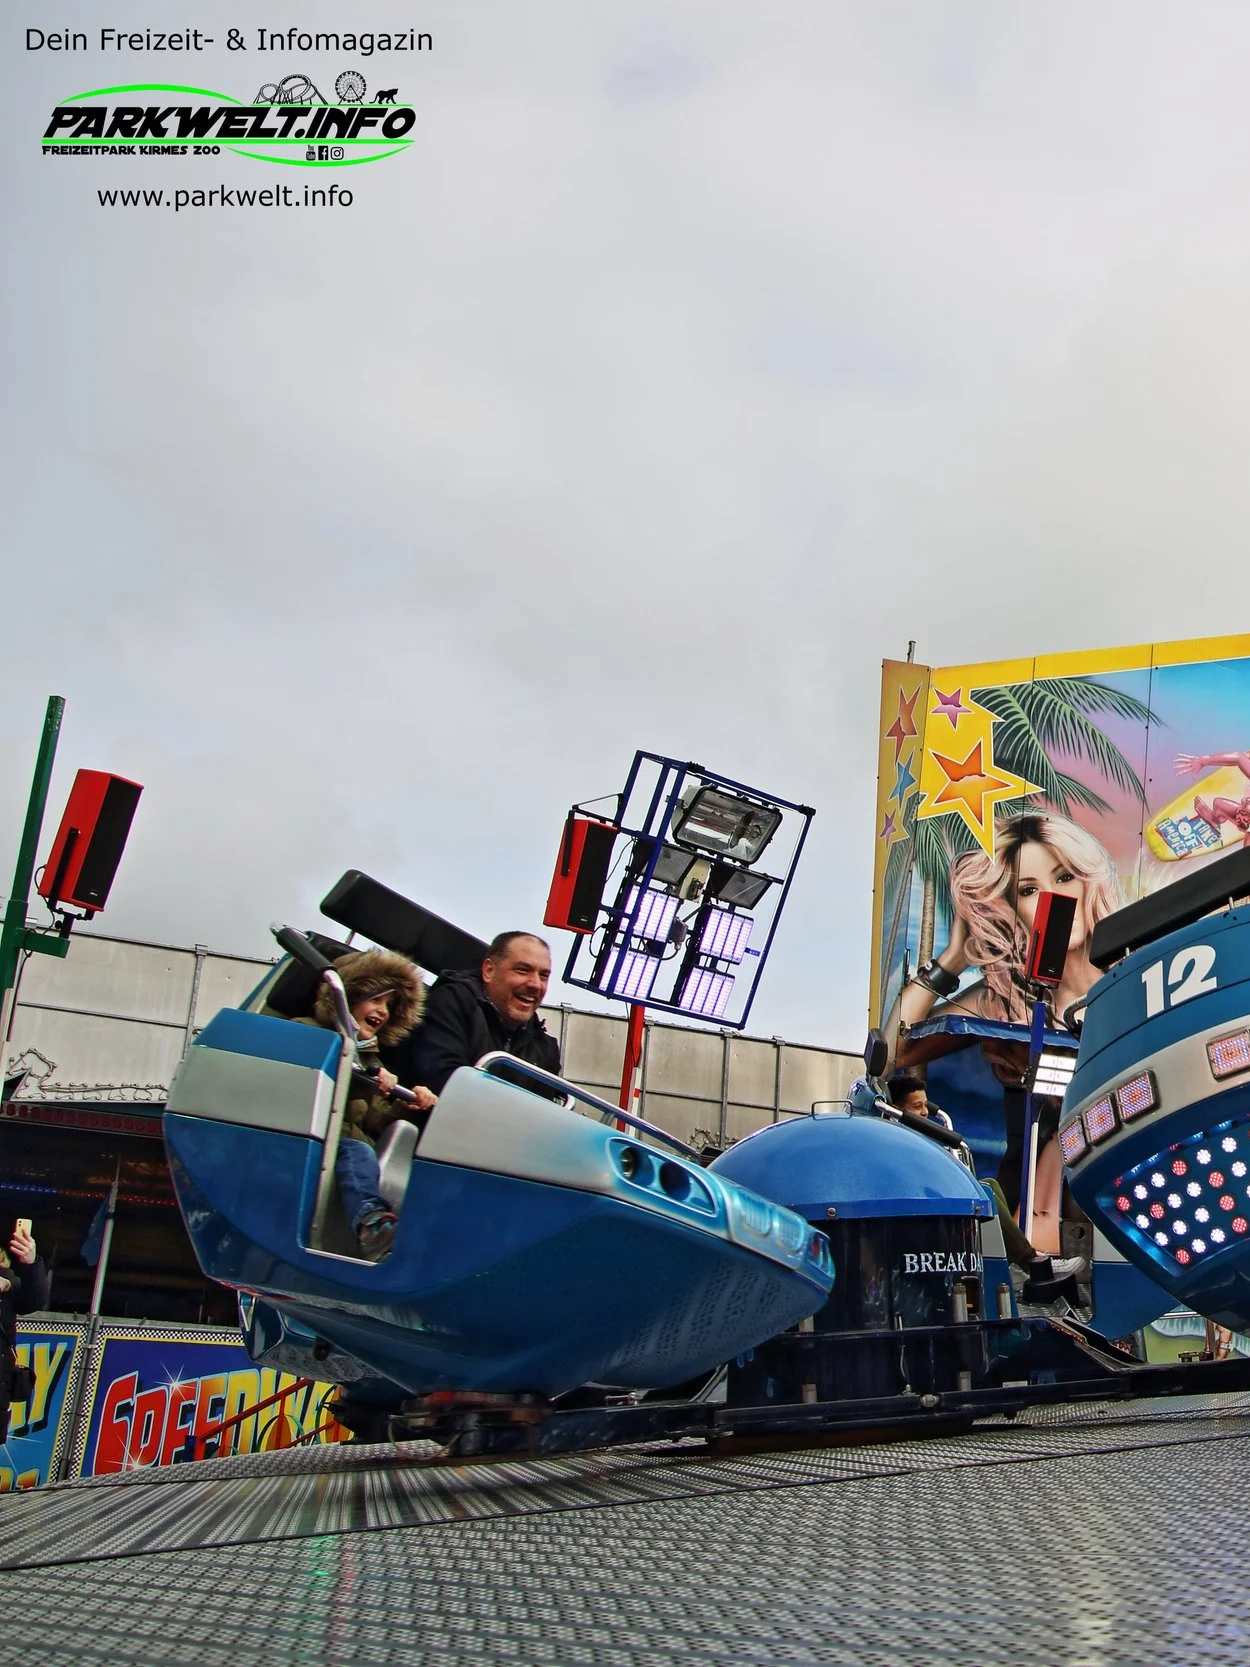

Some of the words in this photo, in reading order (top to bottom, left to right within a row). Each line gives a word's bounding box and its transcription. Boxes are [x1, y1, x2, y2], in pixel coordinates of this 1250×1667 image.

[1141, 944, 1218, 1019] 12
[903, 1251, 967, 1273] BREAK
[970, 1252, 984, 1272] DA
[93, 1367, 336, 1477] SPEEDW
